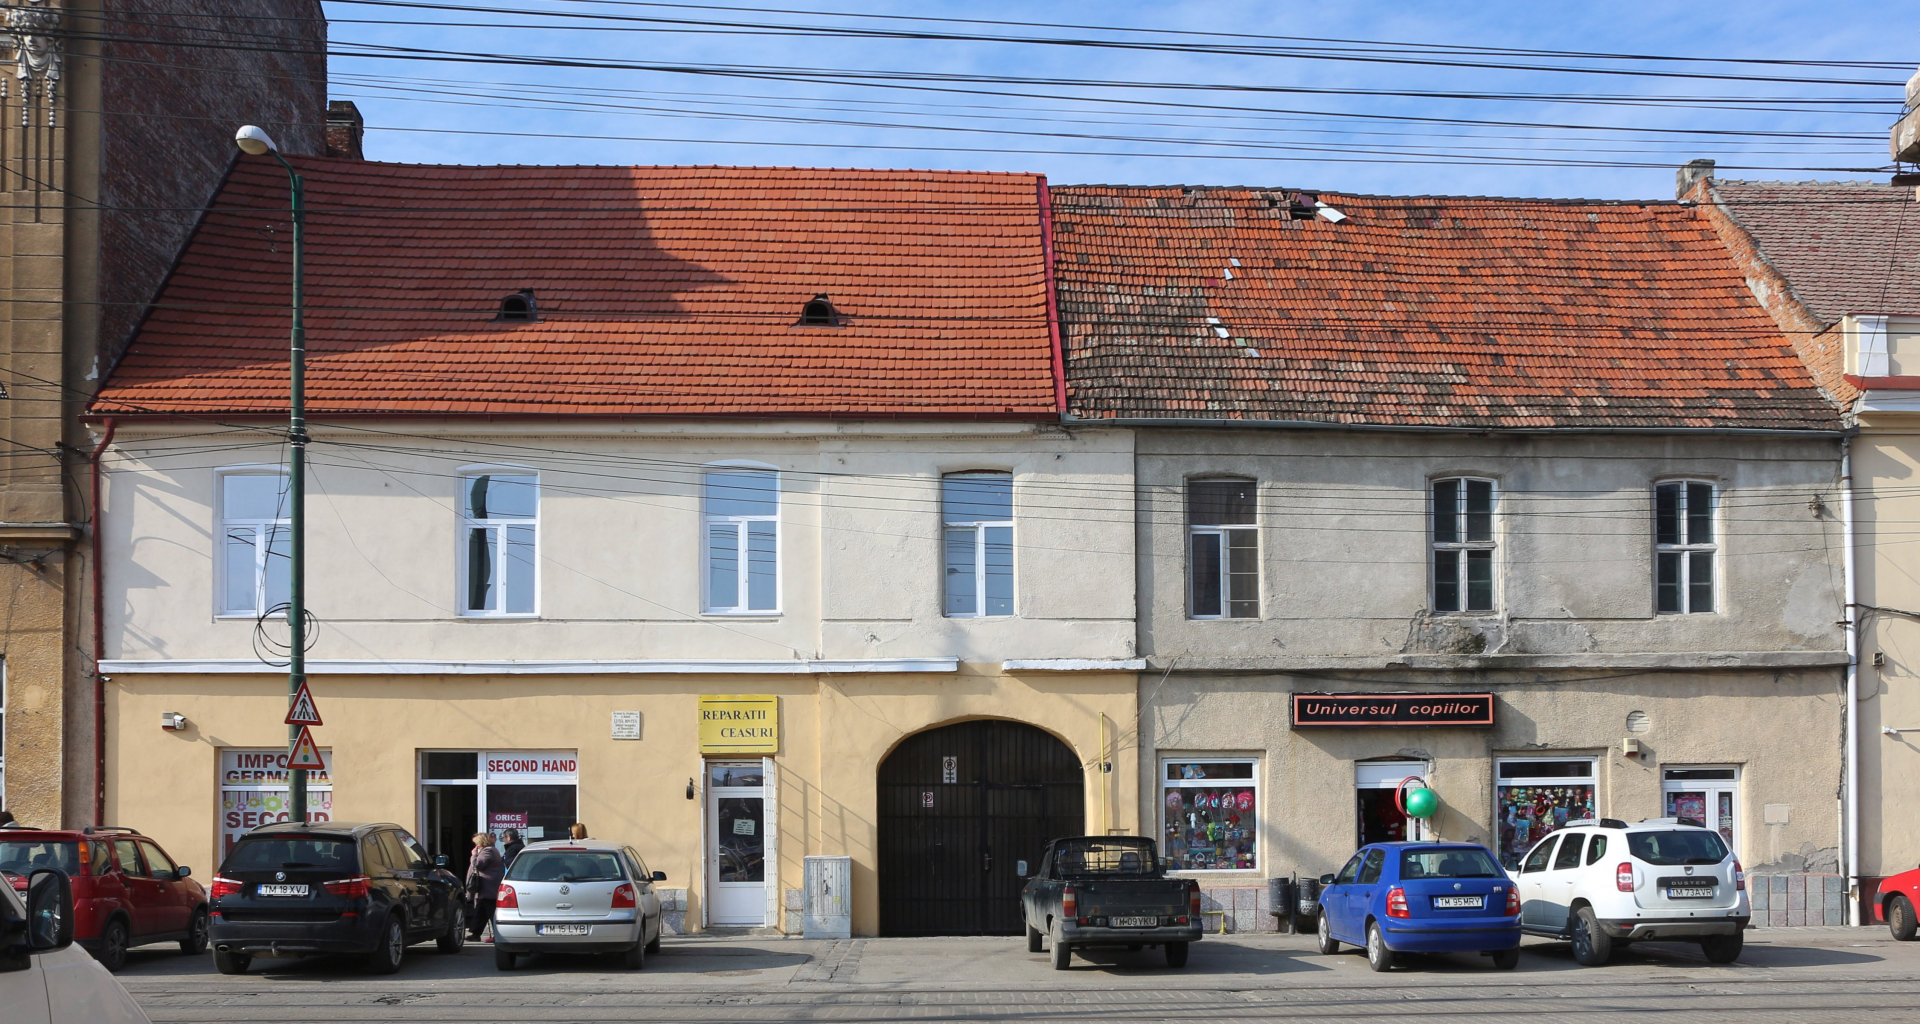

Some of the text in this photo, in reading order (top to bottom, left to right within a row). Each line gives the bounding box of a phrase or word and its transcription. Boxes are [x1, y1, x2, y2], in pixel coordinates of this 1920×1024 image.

[703, 710, 766, 720] REPARATII
[1306, 703, 1480, 716] Universul copiilor
[721, 728, 773, 738] CEASURI
[237, 754, 289, 768] IMPO
[488, 759, 577, 772] SECOND HAND
[226, 770, 331, 784] GERMIA
[264, 885, 307, 894] TM 18 XVJ
